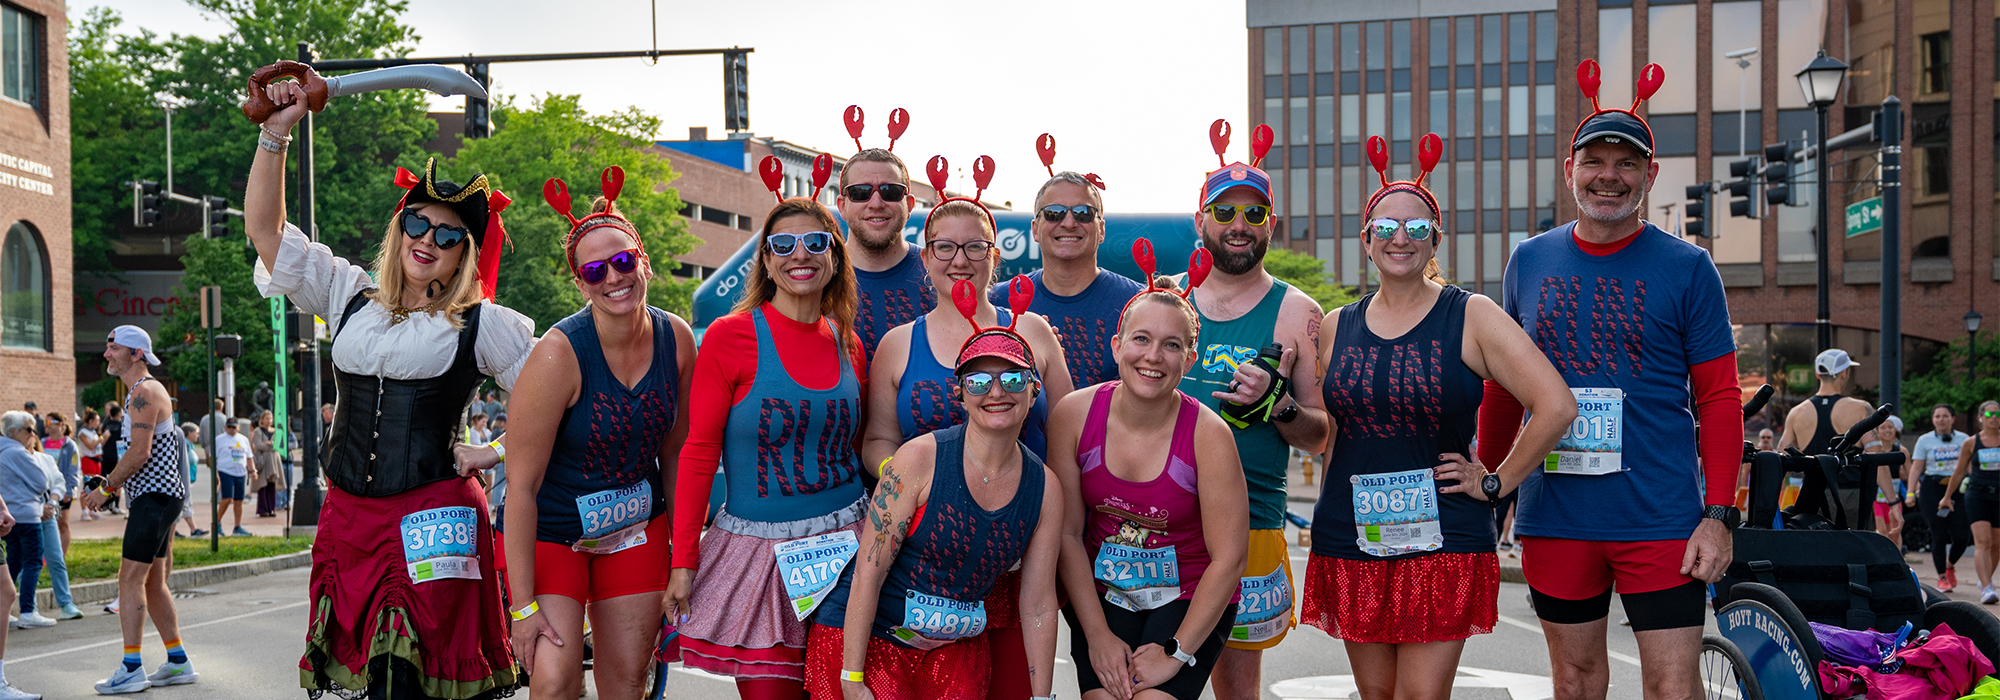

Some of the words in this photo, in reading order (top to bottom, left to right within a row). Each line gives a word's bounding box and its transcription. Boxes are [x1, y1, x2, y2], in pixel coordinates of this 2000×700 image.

[18, 158, 54, 179] CAPITAL
[18, 176, 54, 196] CENTER
[716, 275, 739, 297] do
[95, 287, 183, 316] Cine
[1537, 275, 1647, 377] RUN
[1331, 339, 1442, 439] RUN
[1577, 402, 1612, 412] PORT
[1606, 417, 1614, 439] HALF
[757, 398, 862, 498] RUN
[1560, 455, 1582, 463] Daniel
[1361, 477, 1386, 487] OLD
[1388, 473, 1425, 486] PORT
[587, 493, 613, 507] OLD
[614, 482, 643, 500] PORT
[1356, 487, 1420, 515] 3087
[1422, 488, 1430, 508] HALF
[410, 512, 437, 525] OLD
[440, 509, 471, 520] PORT
[584, 497, 640, 534] 3209
[406, 521, 470, 551] 3738
[786, 551, 813, 564] OLD
[814, 544, 849, 559] PORT
[1105, 546, 1128, 558] OLD
[1130, 550, 1167, 559] PORT
[435, 560, 457, 569] Paula
[788, 557, 846, 588] 4170
[1101, 558, 1159, 581] 3211
[1163, 562, 1171, 578] HALF
[1242, 580, 1260, 589] LD
[1262, 569, 1281, 588] PORT
[1281, 582, 1291, 601] HALF
[916, 595, 945, 608] OLD
[947, 599, 977, 613] PORT
[908, 607, 972, 635] 3481
[968, 617, 981, 636] HALF
[1254, 624, 1268, 634] Neil
[1727, 609, 1752, 632] HOYT
[1754, 611, 1811, 691] RACING.COM
